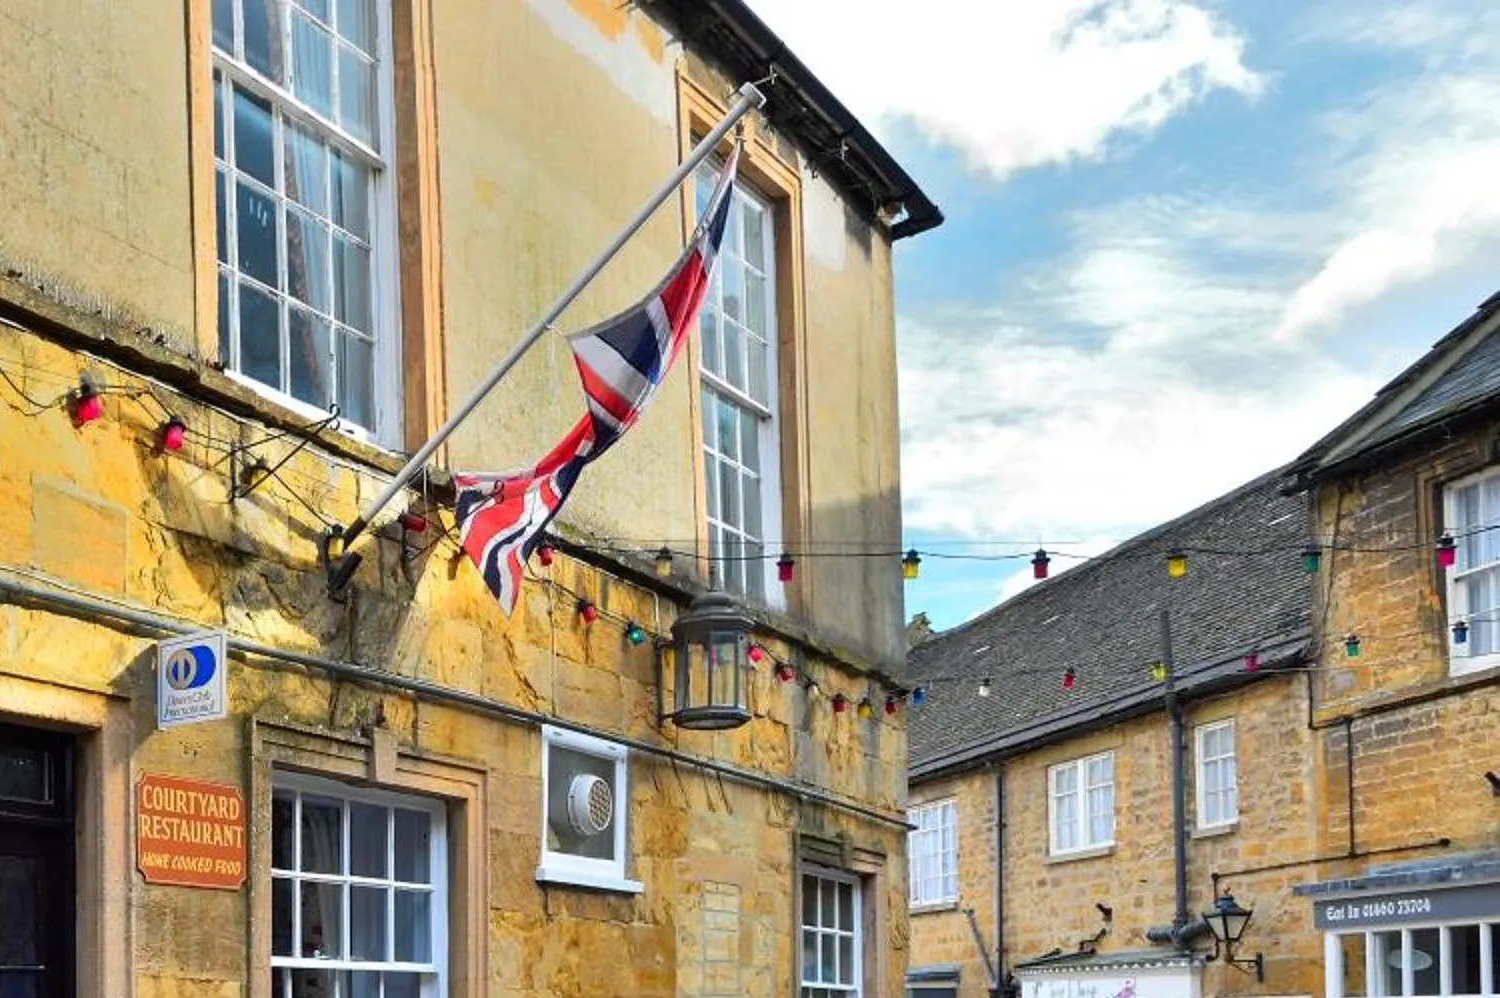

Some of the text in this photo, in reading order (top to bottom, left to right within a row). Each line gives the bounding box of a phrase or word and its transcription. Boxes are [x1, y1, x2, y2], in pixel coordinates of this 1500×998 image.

[143, 785, 240, 820] COURTYARD
[139, 813, 243, 848] RESTAURANT
[141, 852, 241, 875] HOME COOKED FOOD
